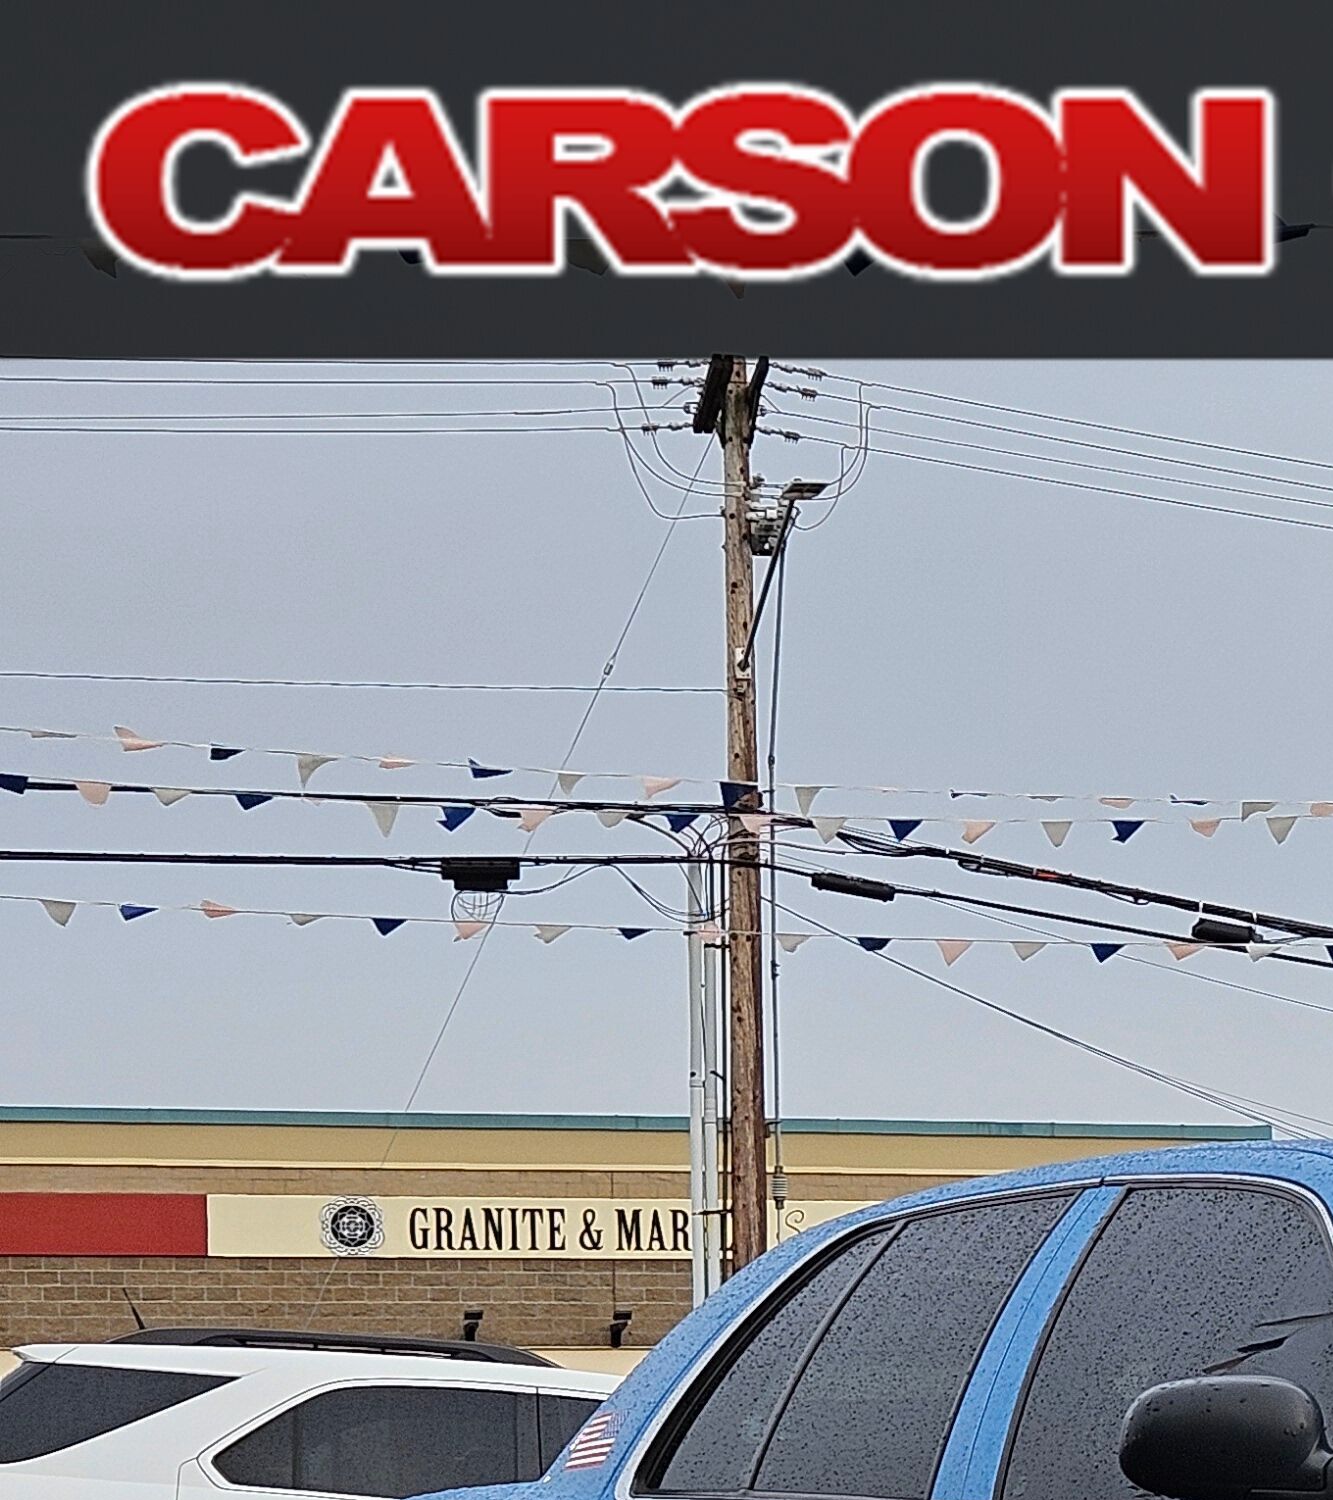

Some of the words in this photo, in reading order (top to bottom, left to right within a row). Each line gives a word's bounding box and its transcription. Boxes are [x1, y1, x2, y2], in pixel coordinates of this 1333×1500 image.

[409, 1207, 566, 1252] GRANITE
[578, 1207, 605, 1252] &
[613, 1208, 693, 1252] MAR
